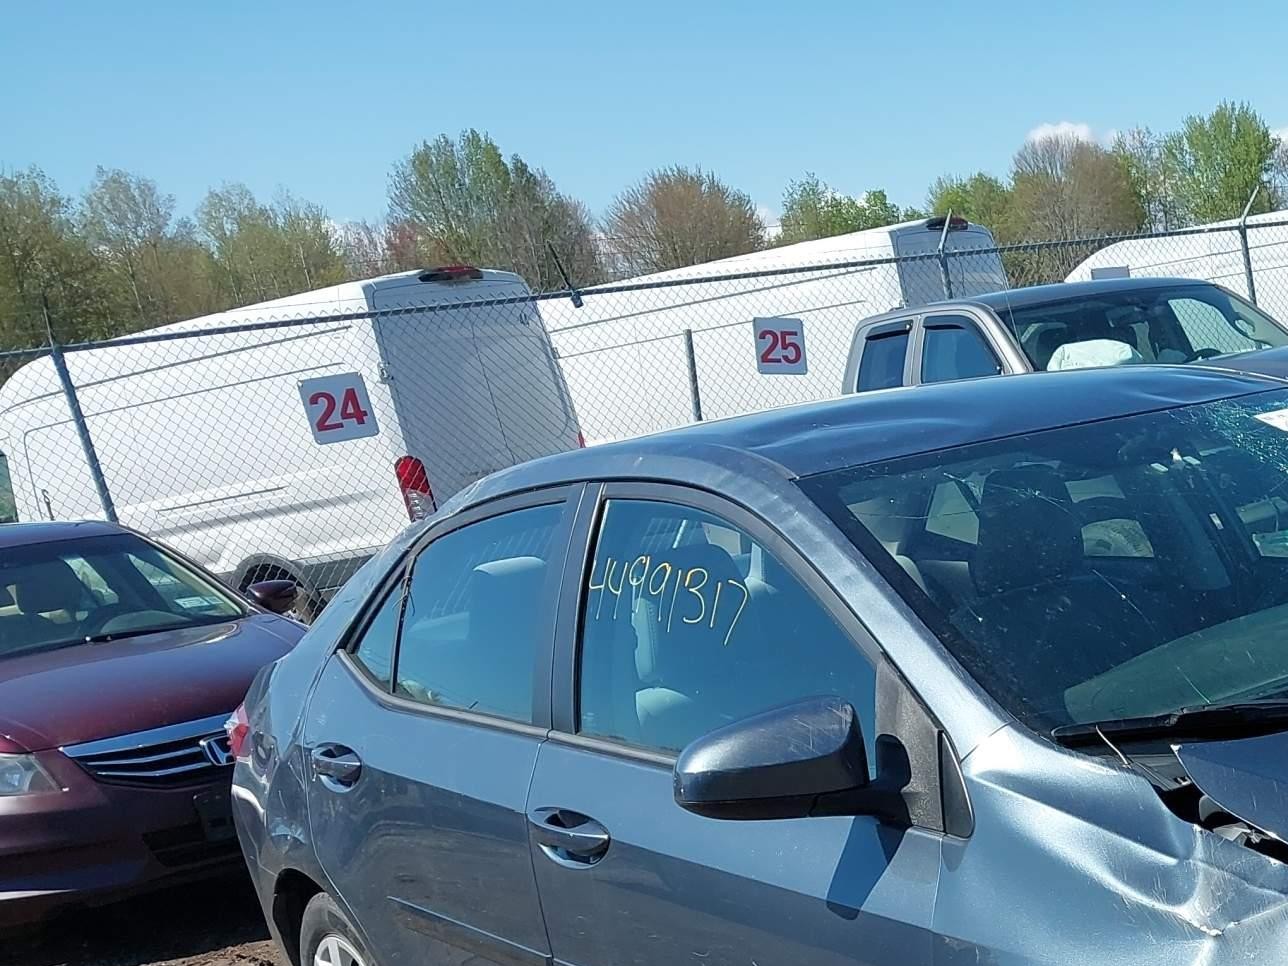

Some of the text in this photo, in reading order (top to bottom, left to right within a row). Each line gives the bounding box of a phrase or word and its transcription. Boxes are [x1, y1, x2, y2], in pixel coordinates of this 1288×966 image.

[758, 329, 802, 365] 25
[308, 387, 369, 432] 24
[588, 555, 749, 646] 44991317
